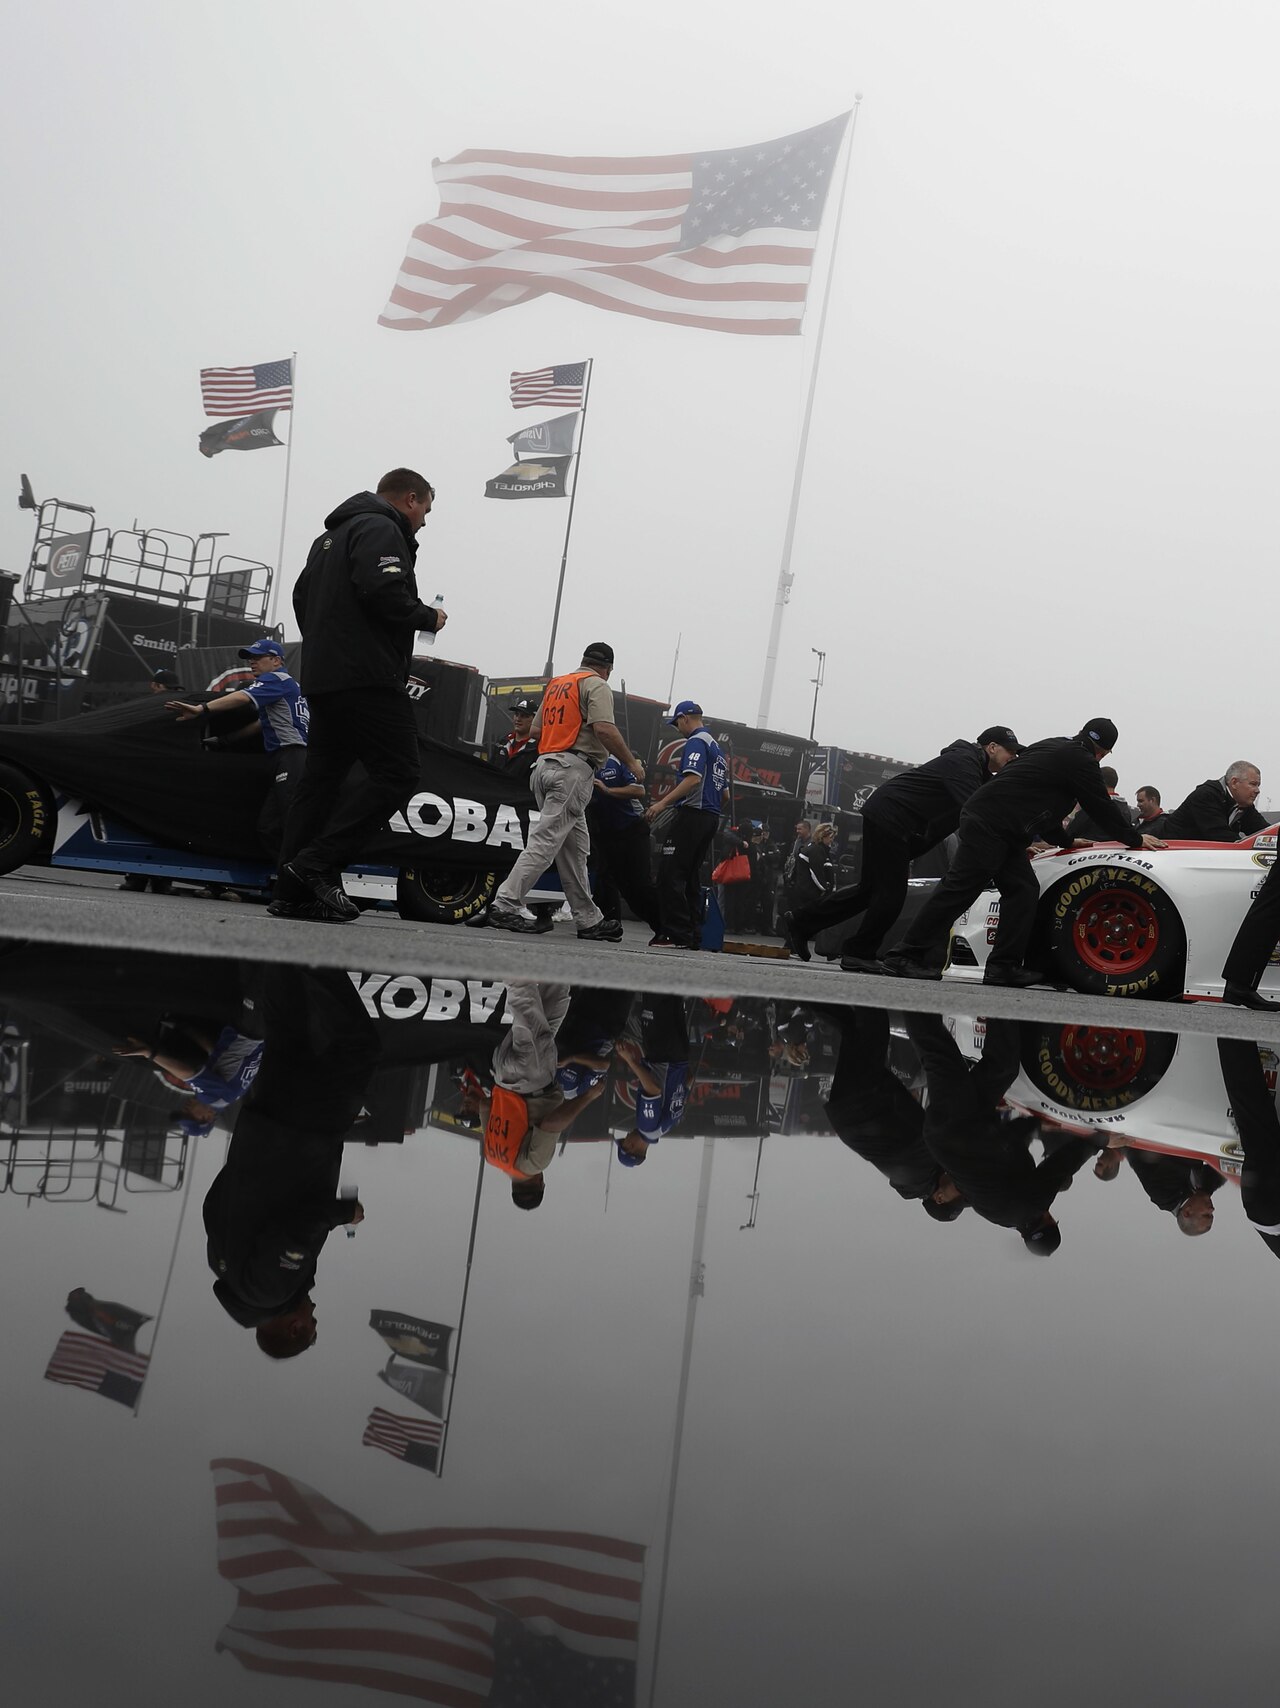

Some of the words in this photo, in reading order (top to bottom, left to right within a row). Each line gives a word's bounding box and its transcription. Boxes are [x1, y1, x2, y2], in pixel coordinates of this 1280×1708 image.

[548, 682, 572, 700] PIR
[544, 705, 565, 727] 031
[689, 752, 700, 761] 48
[26, 790, 45, 838] EAGLE
[1068, 853, 1154, 871] GOODYEAR
[1055, 868, 1160, 918] GOODYEAR
[1105, 970, 1160, 996] EAGLE
